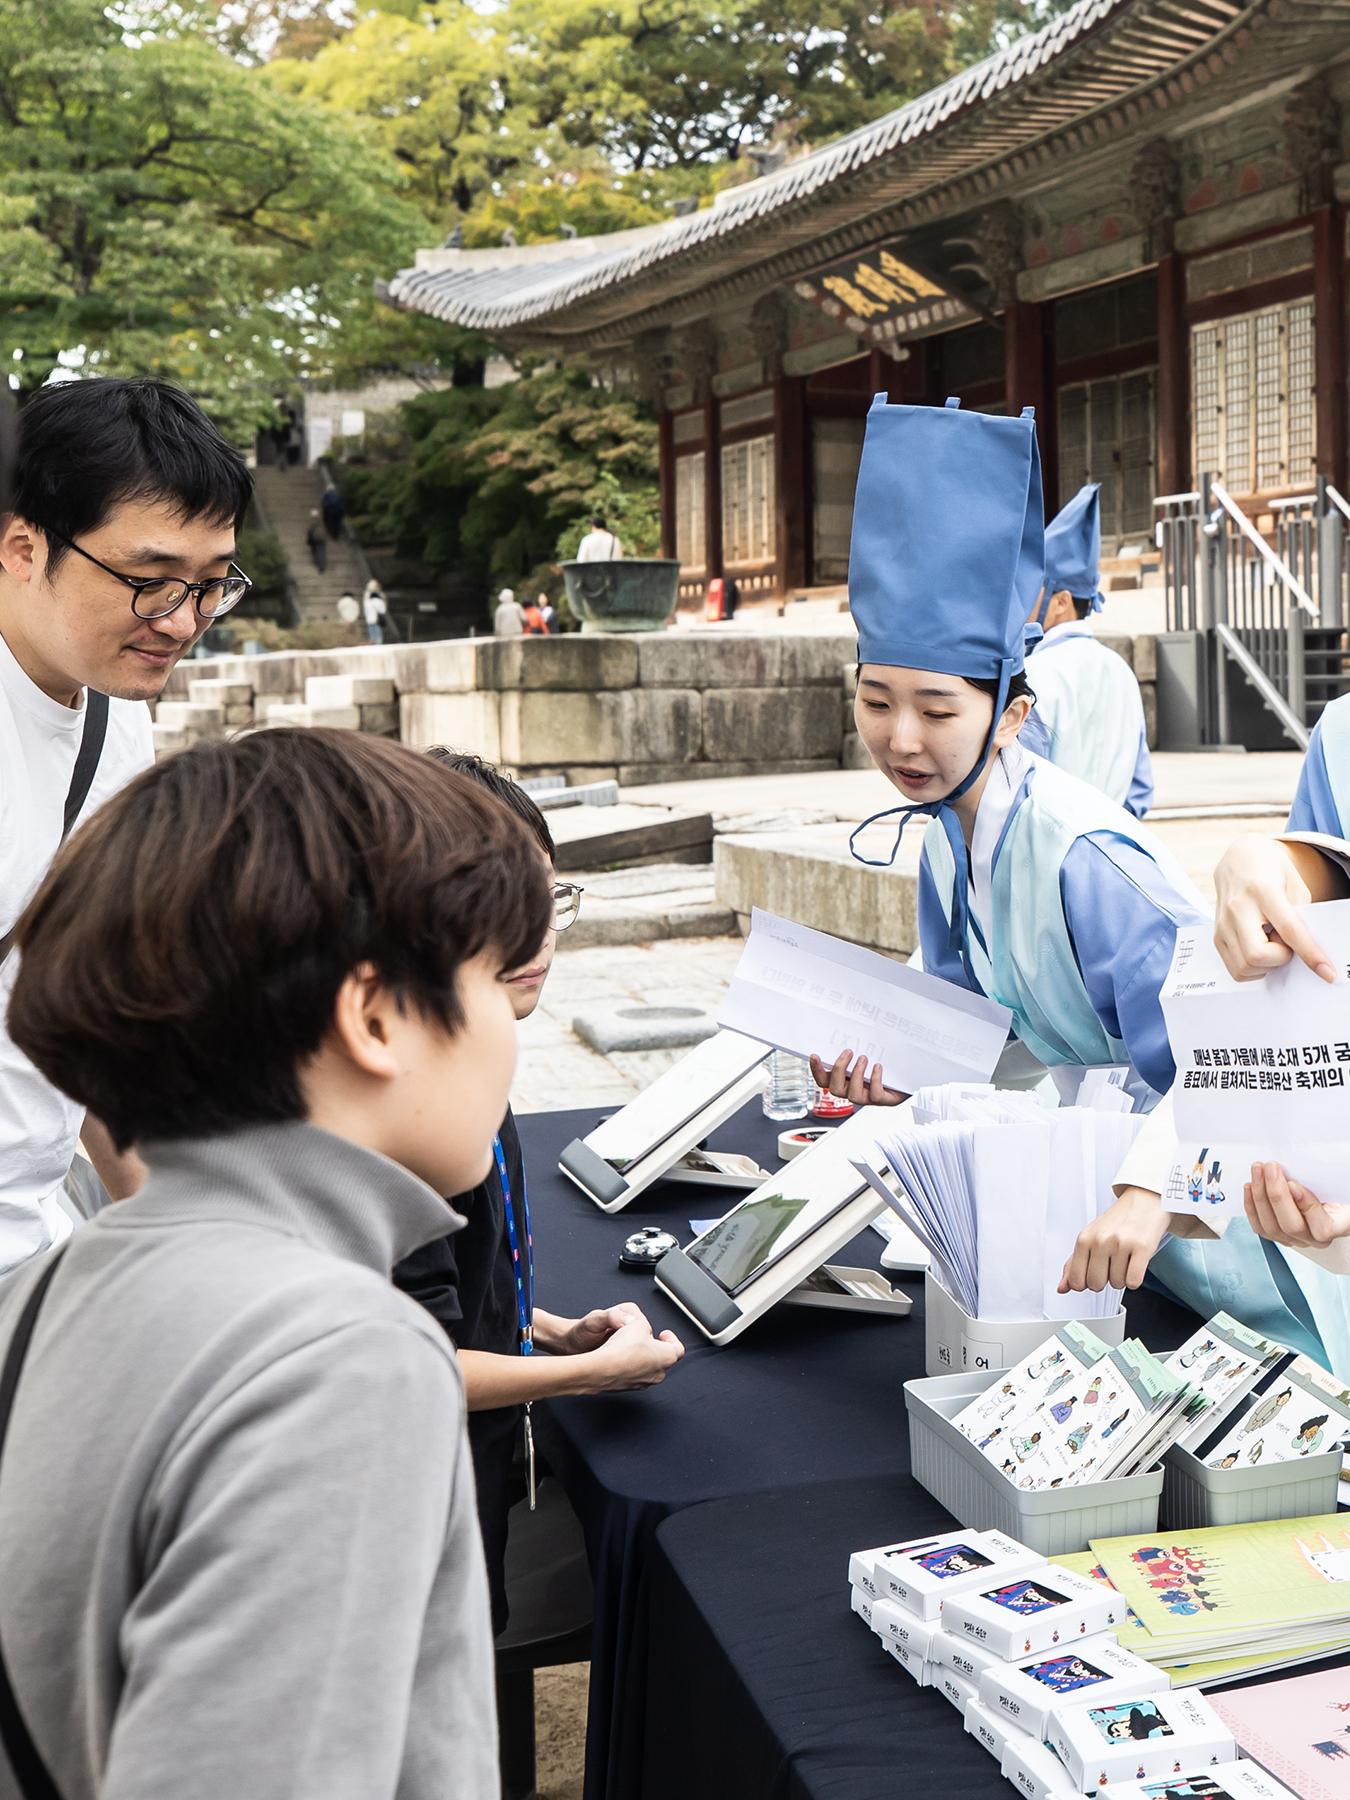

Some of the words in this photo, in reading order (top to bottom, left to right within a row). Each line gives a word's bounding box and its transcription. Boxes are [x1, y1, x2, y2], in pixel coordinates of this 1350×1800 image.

[1193, 1048, 1212, 1066] 매년
[1212, 1048, 1231, 1066] 봄과
[1231, 1048, 1259, 1066] 가을에
[1260, 1048, 1276, 1067] 서울
[1277, 1047, 1299, 1067] 소재
[1302, 1044, 1331, 1066] 5개
[1183, 1070, 1218, 1089] 종묘에서
[1220, 1070, 1257, 1089] 펼쳐지는
[1259, 1071, 1293, 1091] 문화유산
[1295, 1067, 1345, 1090] 축제의
